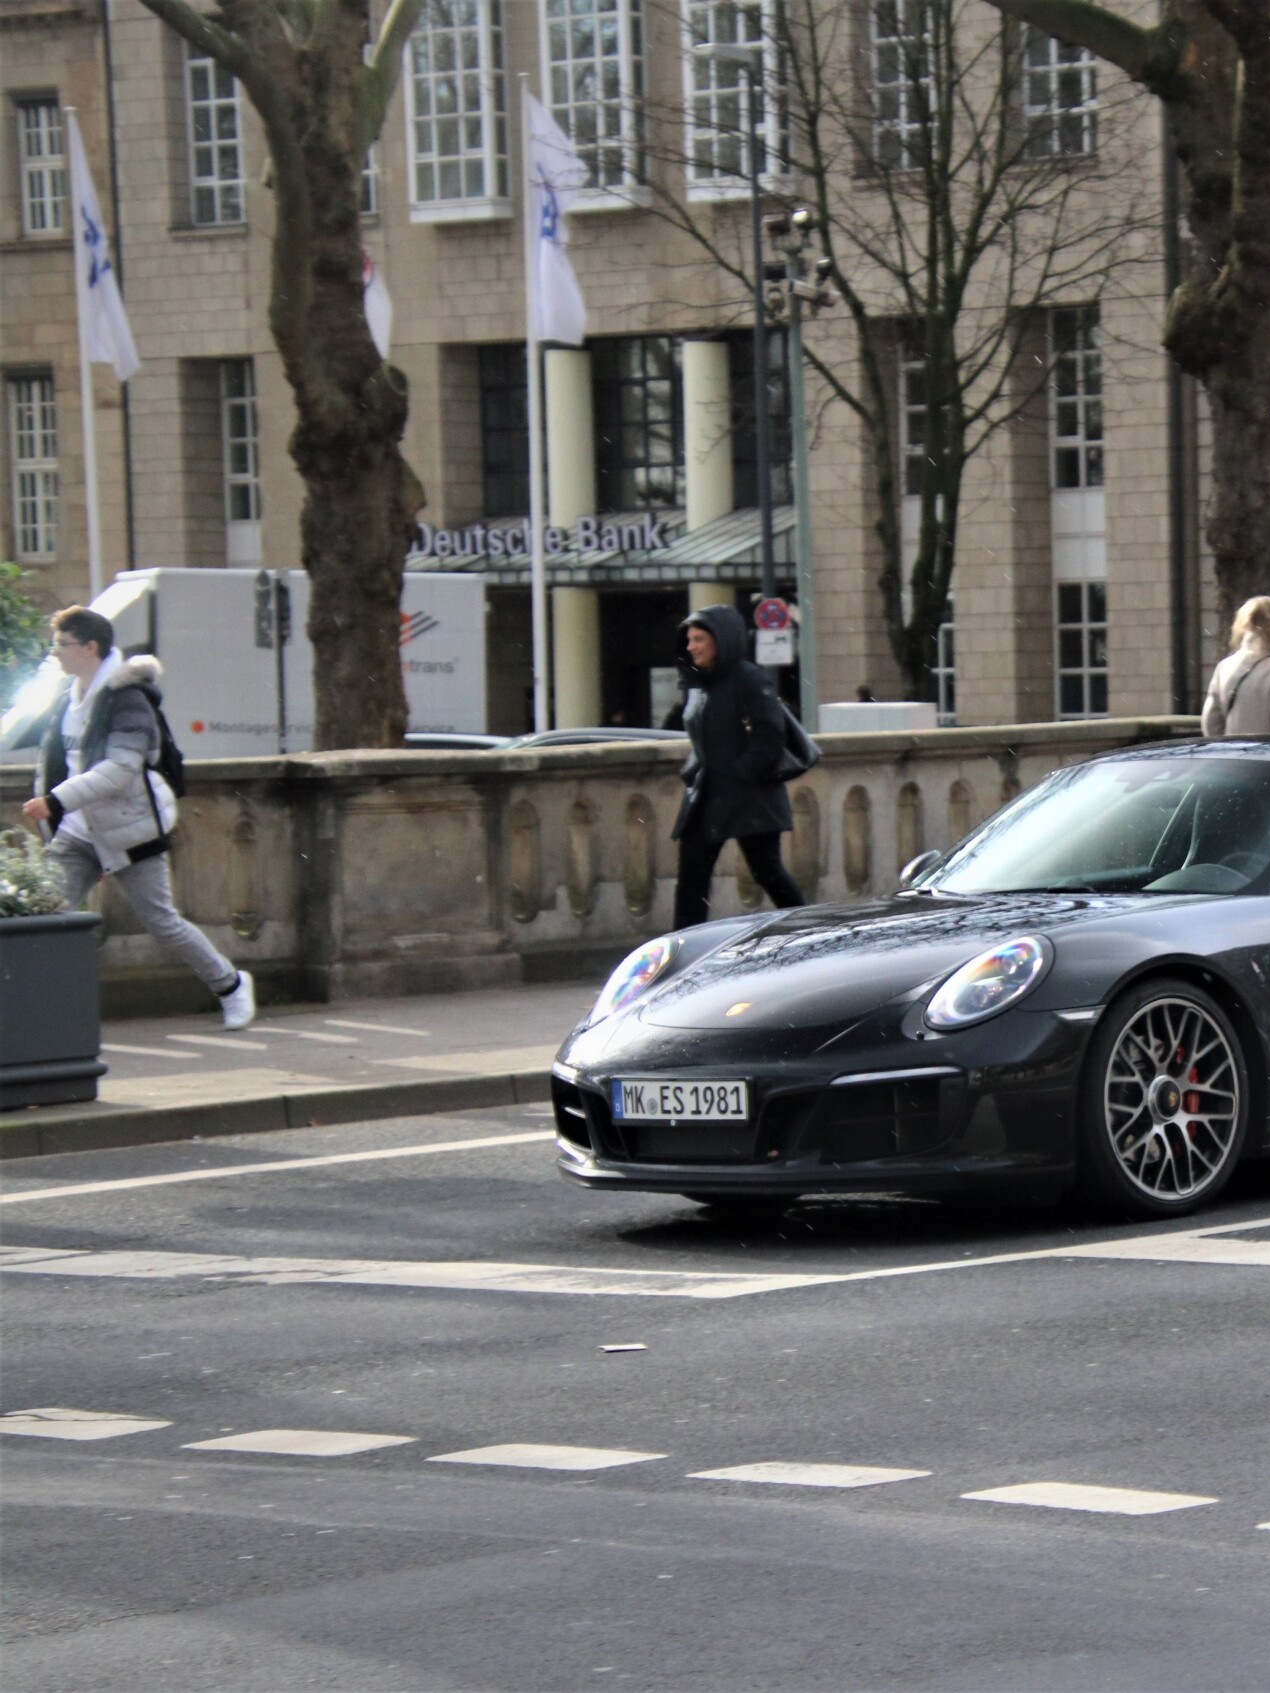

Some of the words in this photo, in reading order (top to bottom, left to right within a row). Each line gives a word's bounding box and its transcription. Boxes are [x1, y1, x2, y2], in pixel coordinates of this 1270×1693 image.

[577, 513, 665, 551] Bank
[623, 1085, 645, 1114] MK
[659, 1086, 684, 1114] ES
[690, 1086, 743, 1115] 1981
